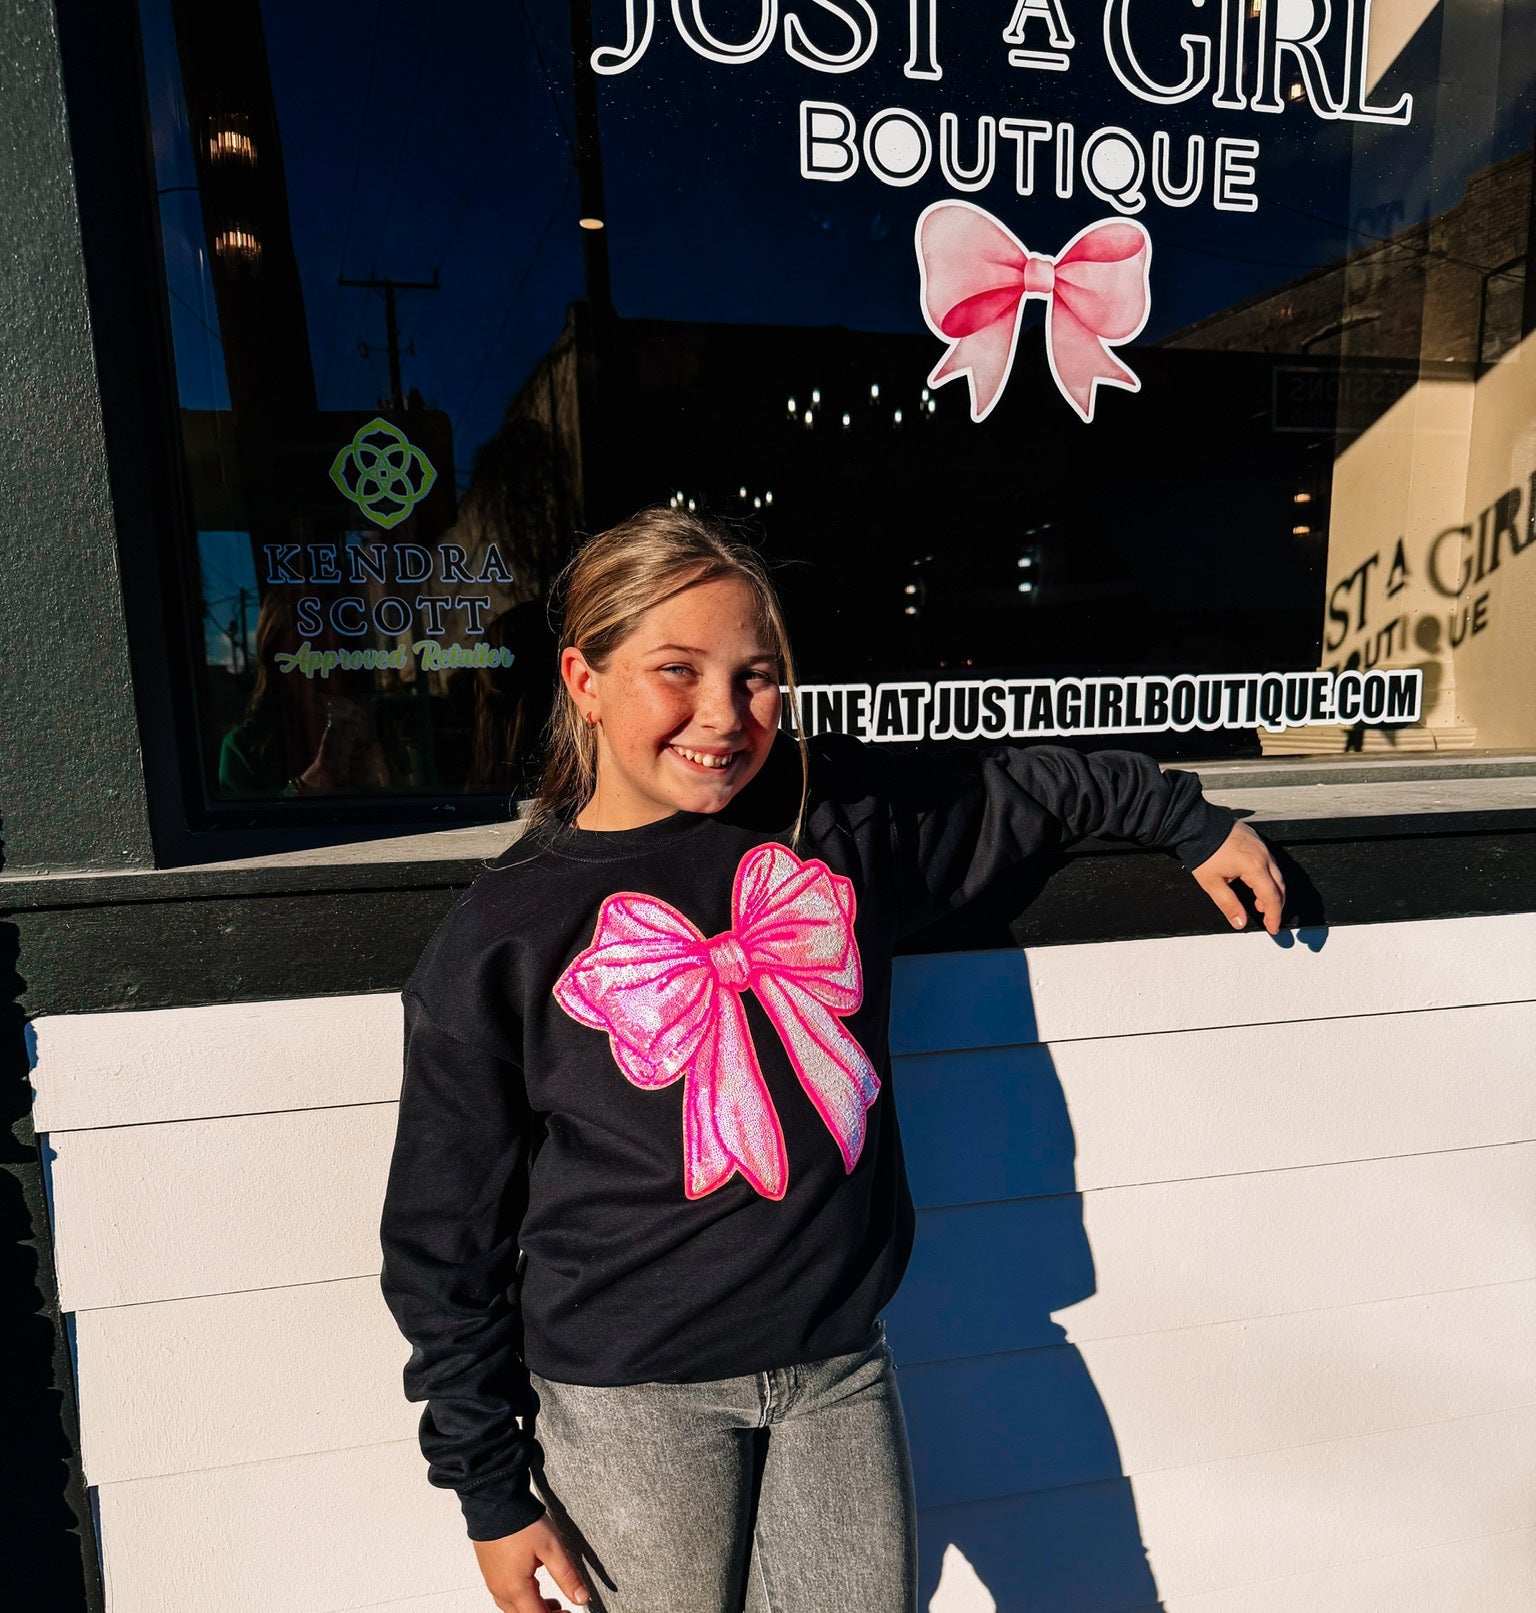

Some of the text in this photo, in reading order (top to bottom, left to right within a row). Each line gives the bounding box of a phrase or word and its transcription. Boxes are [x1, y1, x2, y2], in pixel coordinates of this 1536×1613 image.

[1104, 0, 1414, 126] GIRL
[800, 100, 1260, 215] BOUTIQUE
[264, 543, 514, 584] KENDRA
[297, 595, 491, 637] SCOTT
[274, 639, 515, 679] Approved Retailer
[871, 681, 931, 742] AT
[930, 668, 1423, 740] JUSTAGIRLBOUTIQUE.COM
